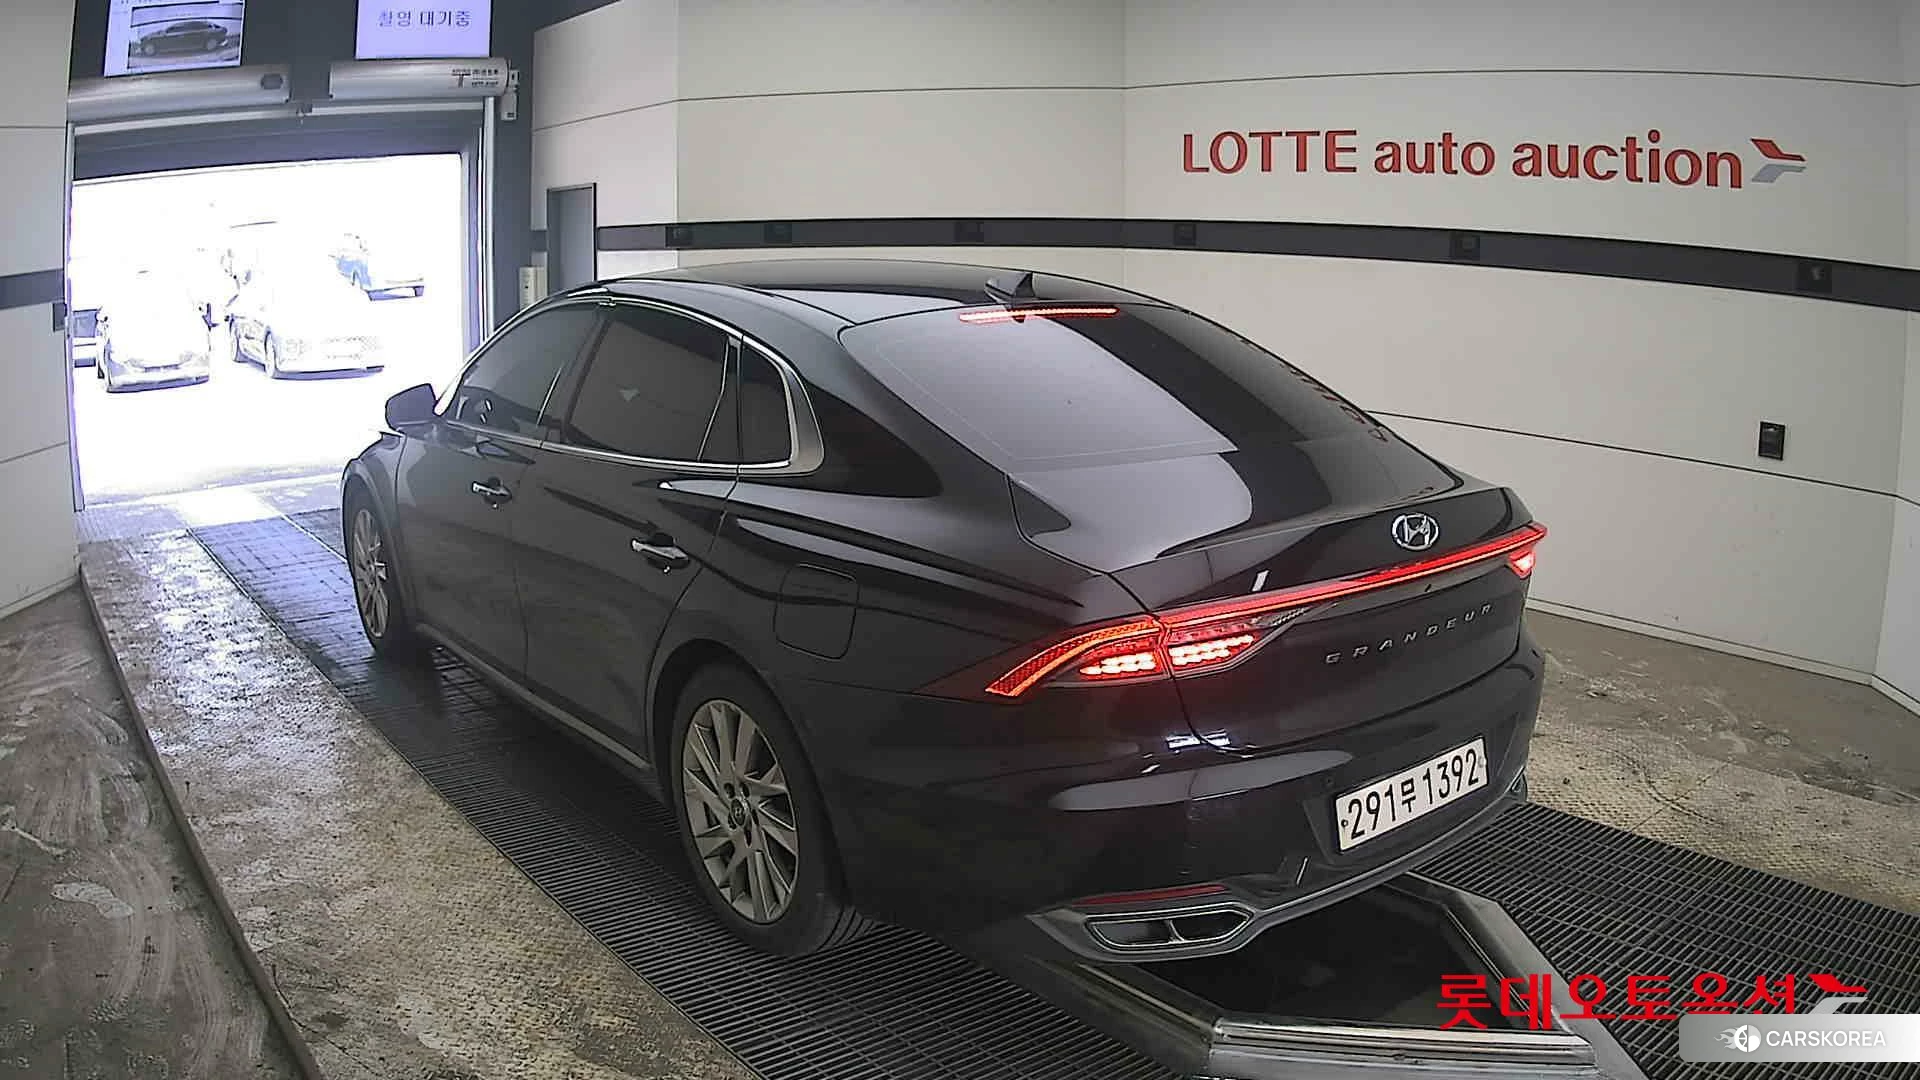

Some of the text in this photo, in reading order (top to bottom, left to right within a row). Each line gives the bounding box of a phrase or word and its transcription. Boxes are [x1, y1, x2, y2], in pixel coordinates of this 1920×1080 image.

[420, 10, 470, 27] 대기중
[1183, 129, 1742, 189] LOTTE auto auction
[1325, 604, 1492, 664] GRANDEUR
